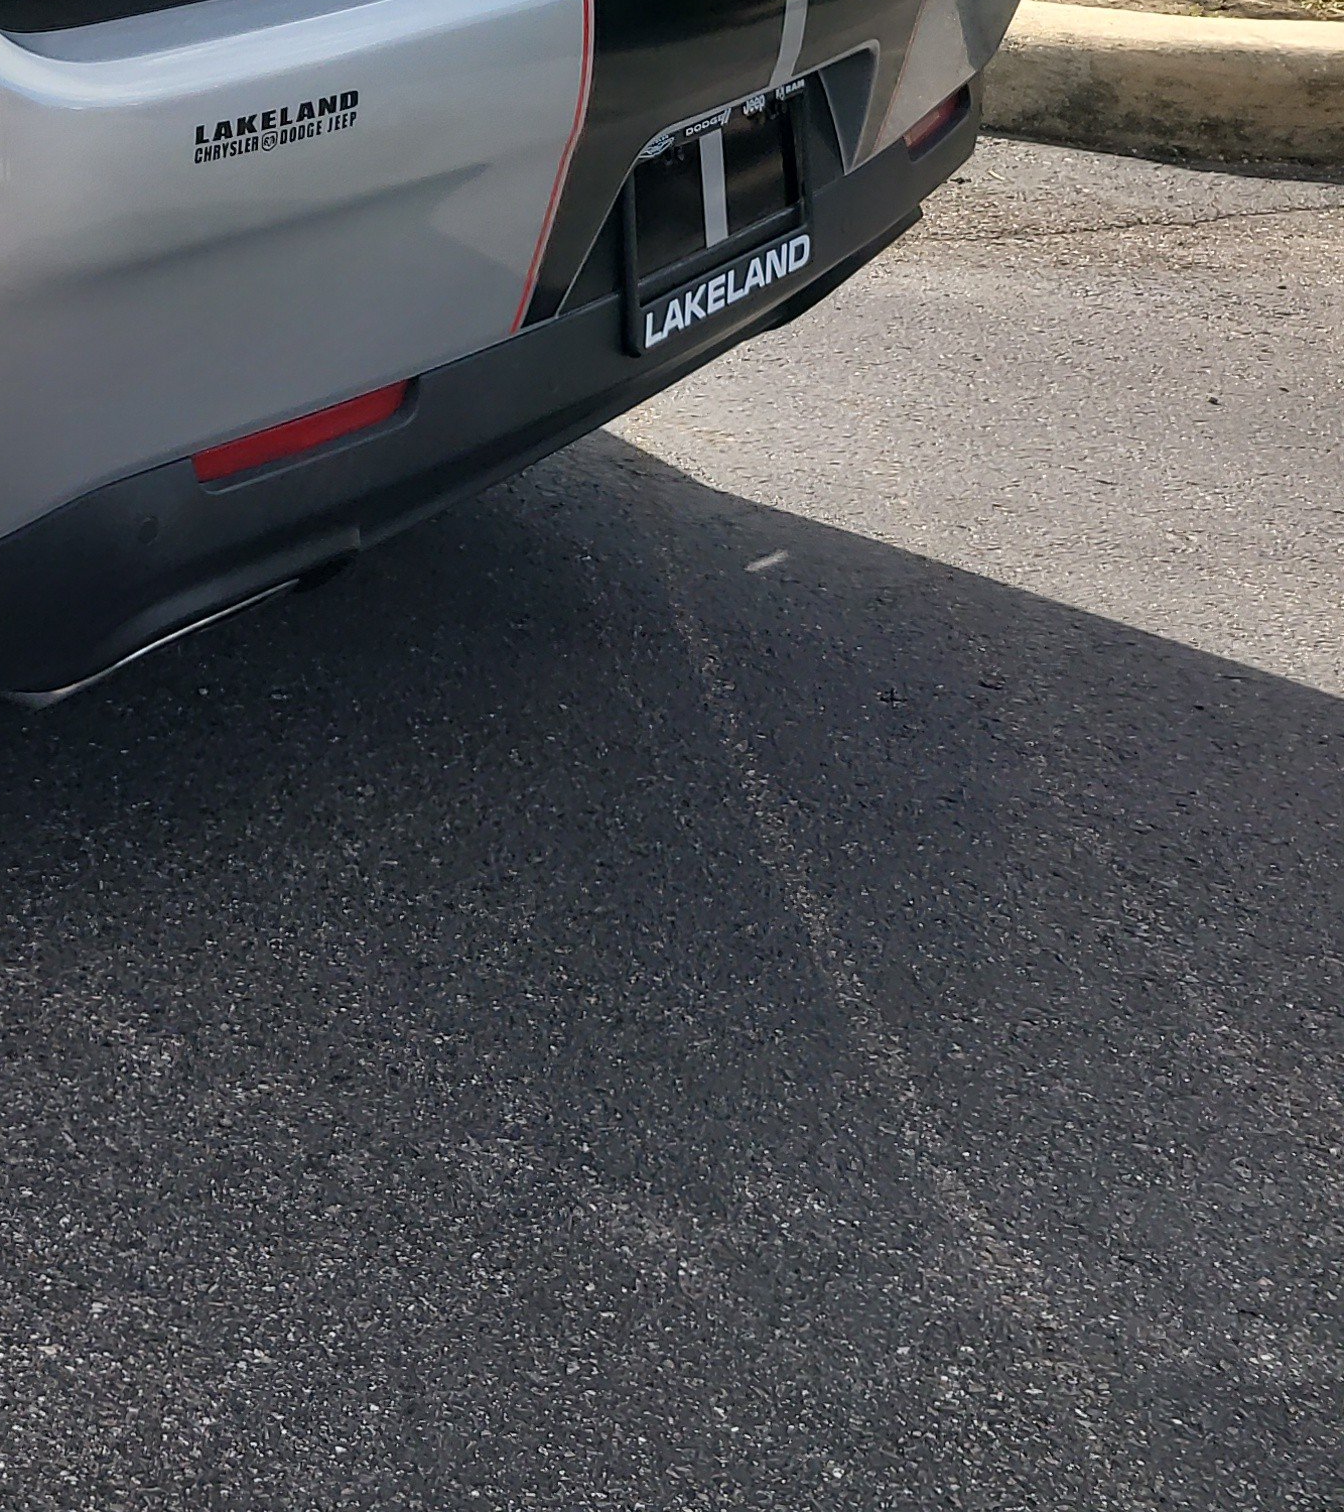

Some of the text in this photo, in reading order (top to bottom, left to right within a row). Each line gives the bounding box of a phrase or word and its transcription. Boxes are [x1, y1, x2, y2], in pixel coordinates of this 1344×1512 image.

[194, 111, 357, 164] CHRYSLER DODGE JEEP
[195, 90, 359, 145] LAKELAND
[645, 234, 810, 349] LAKELAND
